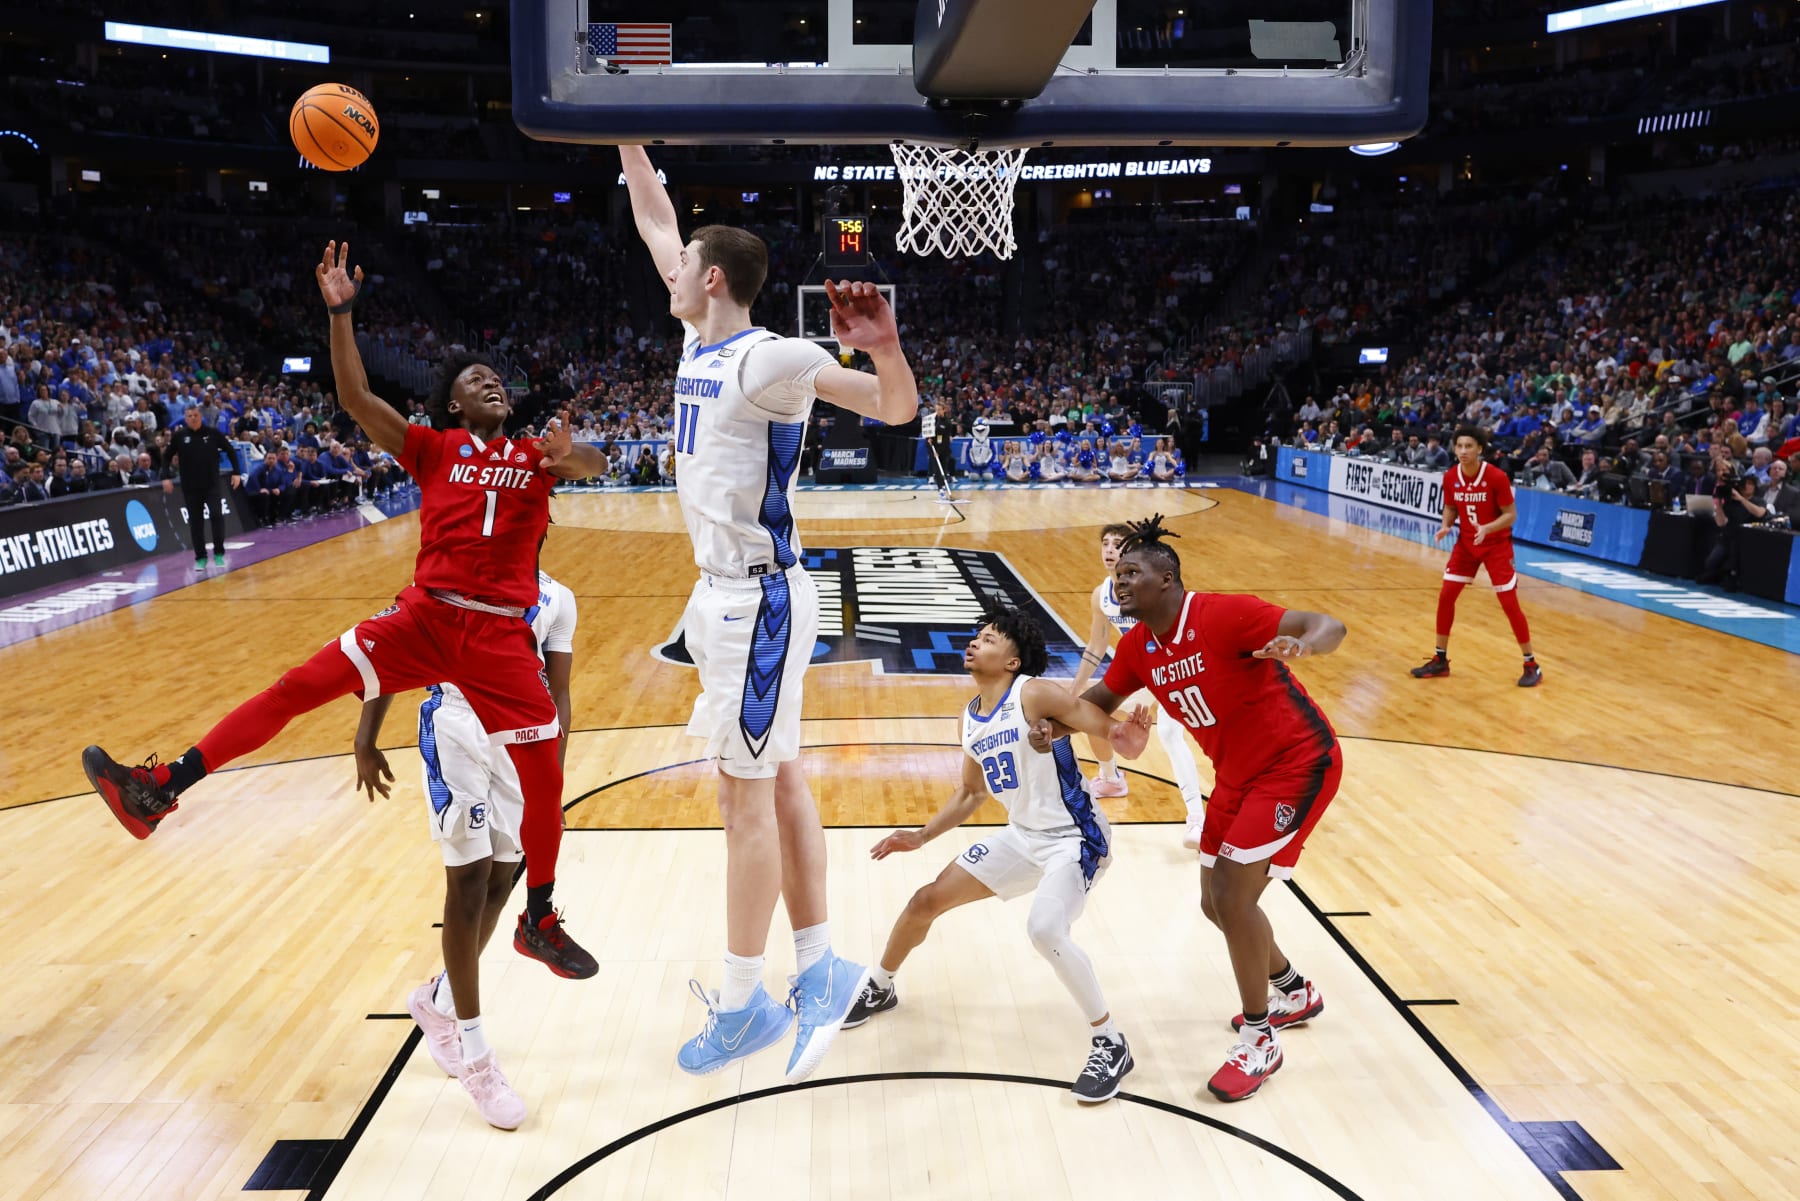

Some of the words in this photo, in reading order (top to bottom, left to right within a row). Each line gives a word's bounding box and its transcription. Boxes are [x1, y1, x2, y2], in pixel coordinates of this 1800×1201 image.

[343, 104, 377, 139] NCAA
[814, 166, 839, 181] NC
[842, 166, 896, 181] STATE
[1021, 162, 1121, 180] CREIGHTON
[1125, 158, 1212, 177] BLUEJAYS
[837, 220, 863, 233] 7:56
[841, 234, 859, 252] 14
[677, 402, 700, 455] 11
[831, 450, 855, 459] MARCH
[833, 457, 866, 466] MADNESS
[448, 463, 478, 484] NC
[478, 466, 534, 490] STATE
[1345, 462, 1374, 495] FIRST
[1380, 469, 1425, 510] SECOND
[1464, 491, 1487, 503] STATE
[481, 489, 498, 538] 1
[1466, 504, 1478, 525] 5
[1561, 511, 1584, 528] MARCH
[132, 522, 157, 541] NCAA
[1562, 525, 1593, 543] MADNESS
[0, 517, 115, 576] ENT-ATHLETES
[1151, 665, 1168, 687] NC
[1167, 652, 1206, 682] STATE
[1167, 685, 1217, 729] 30
[515, 728, 540, 742] PACK
[970, 727, 1020, 757] CREIGHTON
[981, 751, 1019, 794] 23
